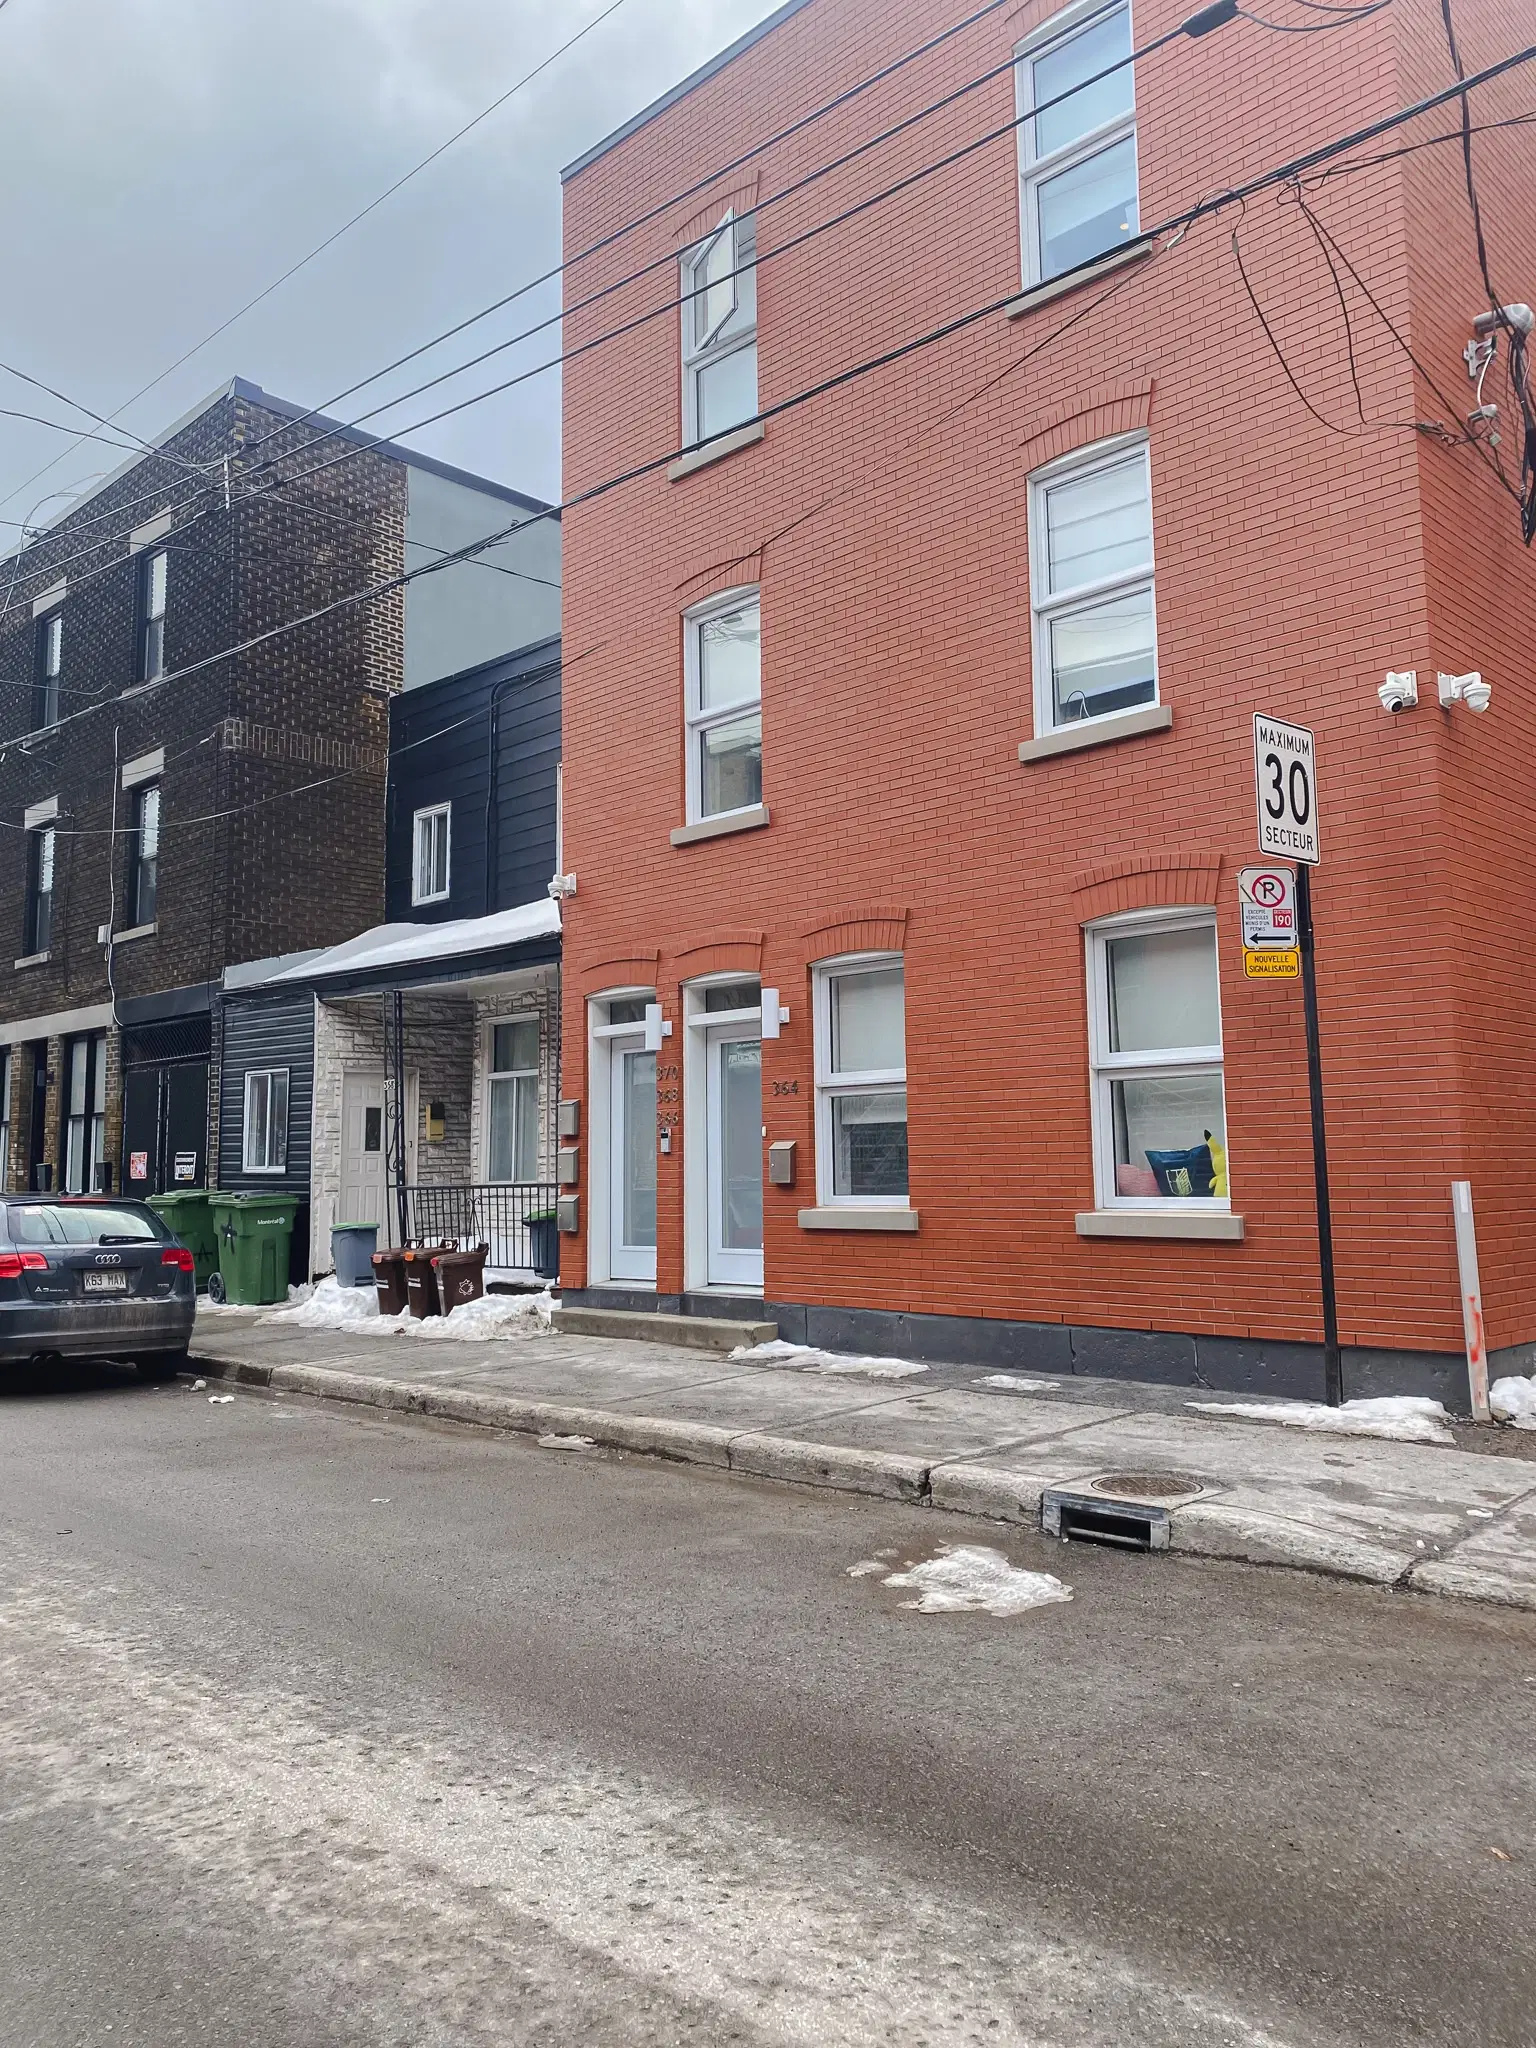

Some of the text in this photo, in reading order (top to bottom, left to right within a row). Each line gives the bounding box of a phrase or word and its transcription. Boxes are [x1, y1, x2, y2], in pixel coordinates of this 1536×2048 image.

[1259, 725, 1310, 756] MAXIMUM
[1265, 752, 1310, 826] 30
[1265, 825, 1314, 852] SECTEUR
[1263, 881, 1275, 899] P
[1274, 914, 1292, 926] 190
[1254, 955, 1289, 963] NOUVELLE
[1248, 965, 1296, 973] SIGNALISATION
[656, 1064, 678, 1081] 370
[656, 1087, 679, 1104] 368
[772, 1080, 799, 1096] 364
[656, 1111, 679, 1126] 366
[85, 1273, 124, 1286] K63 MAX
